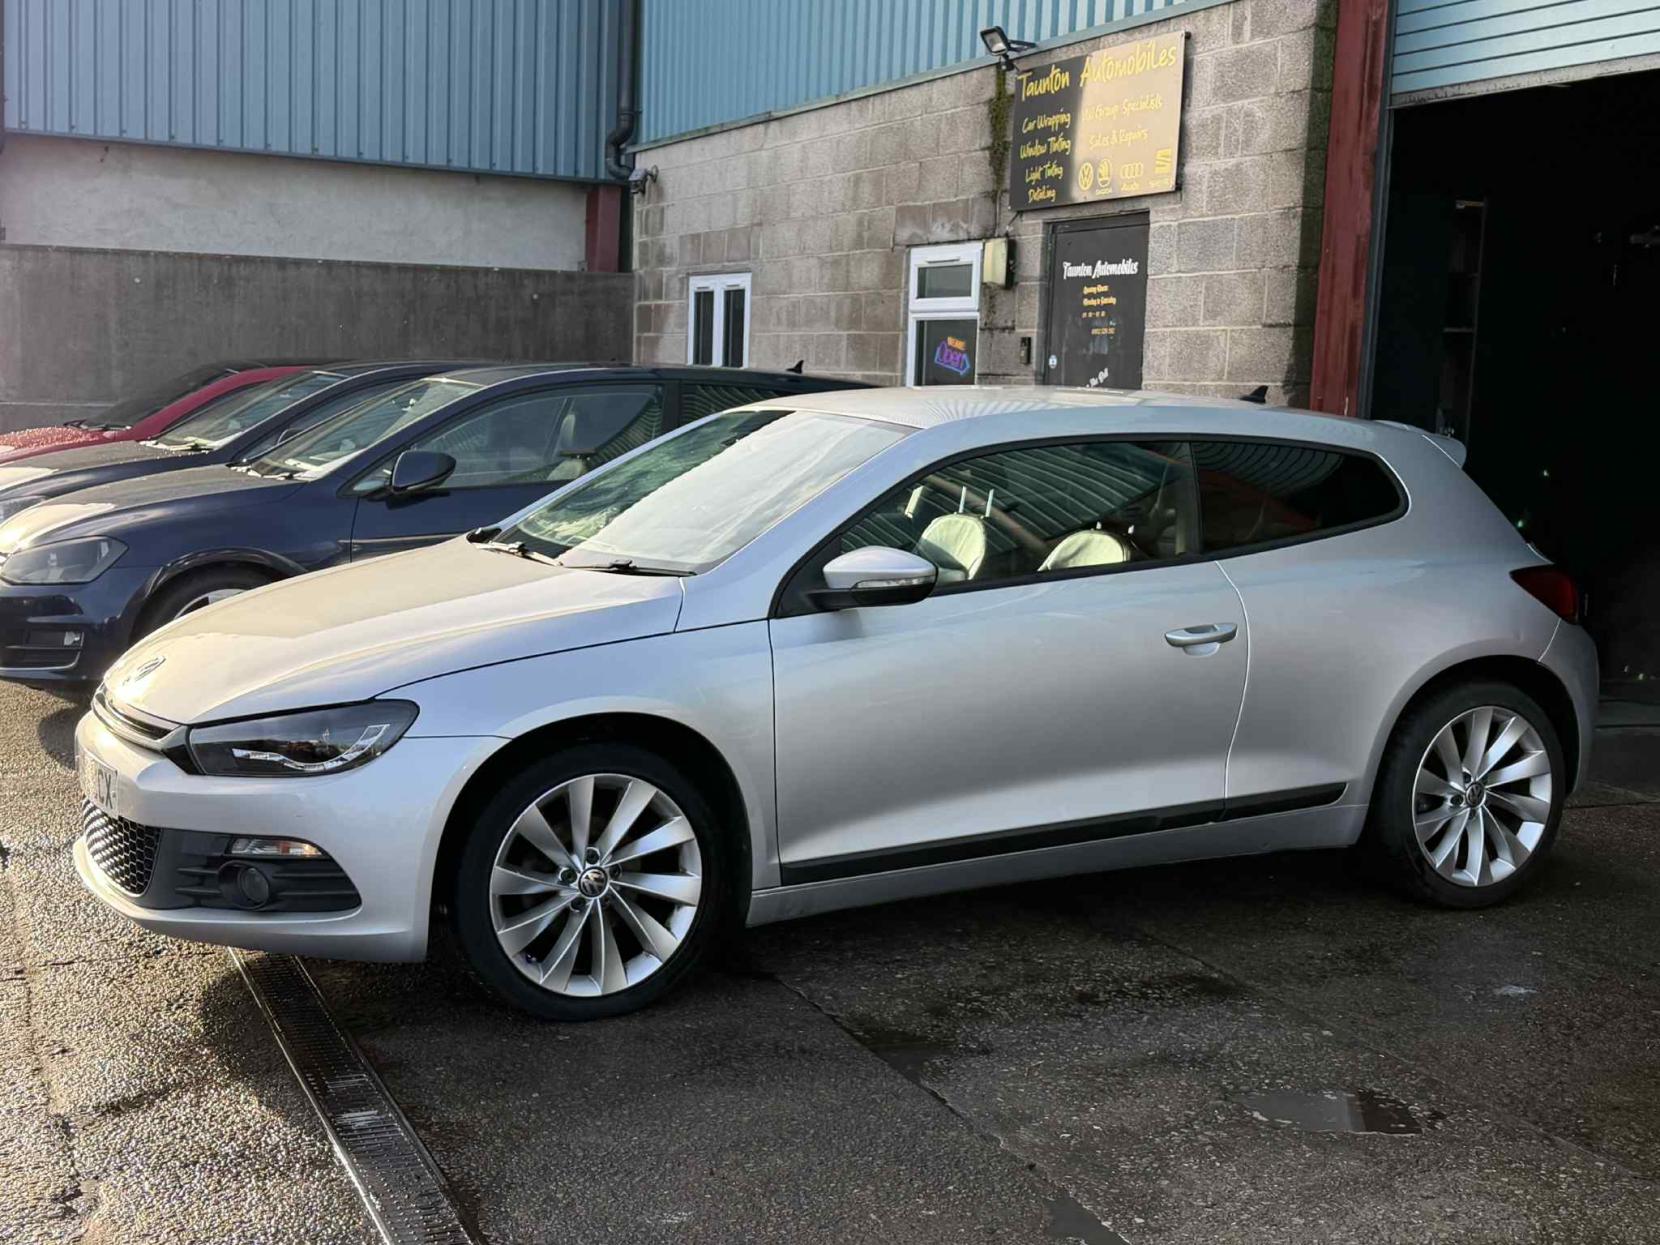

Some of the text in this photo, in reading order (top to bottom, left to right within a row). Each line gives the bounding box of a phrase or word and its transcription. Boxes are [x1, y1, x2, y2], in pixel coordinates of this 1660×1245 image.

[1017, 41, 1177, 101] Taunton Automobiles
[1037, 108, 1072, 132] Wrapping
[1019, 139, 1047, 160] Window
[1025, 166, 1043, 186] Light
[1063, 258, 1139, 280] Taunton Automobiles
